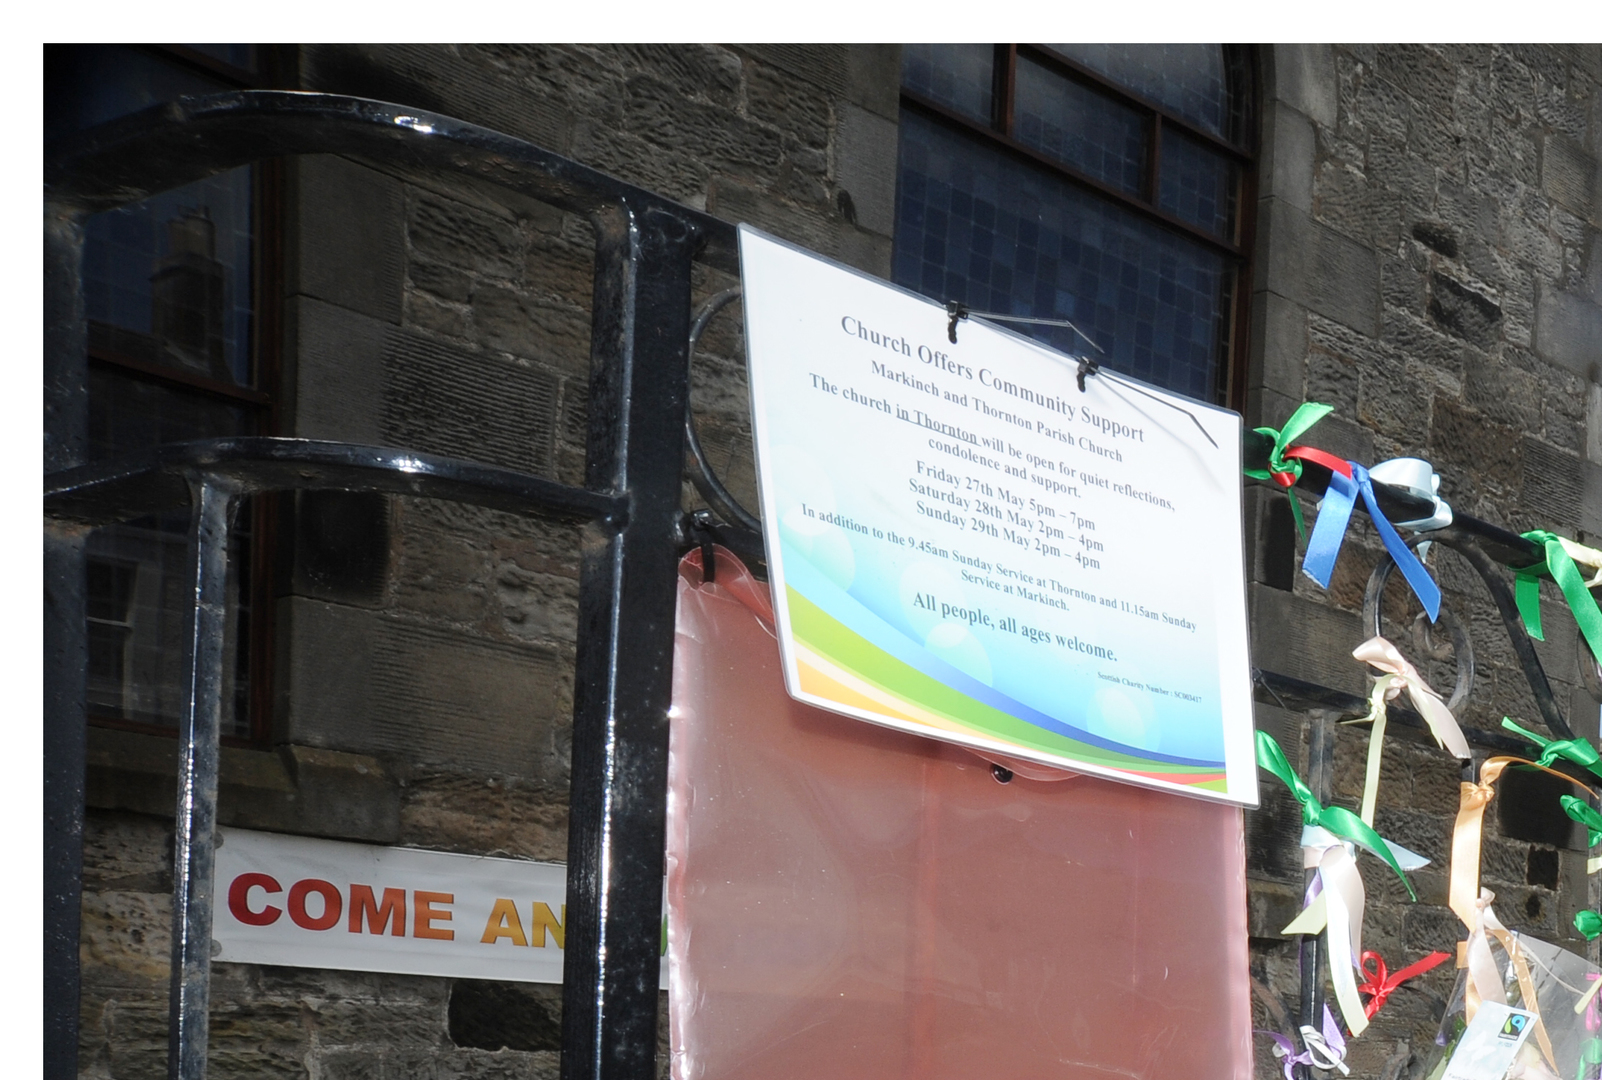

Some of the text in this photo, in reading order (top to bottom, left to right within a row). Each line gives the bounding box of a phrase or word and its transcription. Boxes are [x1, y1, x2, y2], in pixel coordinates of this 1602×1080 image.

[840, 315, 1144, 443] Church Offers Community Support
[871, 359, 1123, 463] Markinch and Thornton Parish Church
[809, 372, 1175, 512] The church in Thornton will be open for quiet reflections,
[928, 438, 1081, 499] condolence and support.
[908, 478, 971, 513] Saturday
[974, 498, 1003, 520] 28th
[1006, 509, 1034, 533] May
[1038, 519, 1064, 540] 2pm
[1078, 533, 1104, 552] 4pm
[916, 459, 961, 490] Friday
[965, 476, 994, 498] 27th
[997, 486, 1025, 511] May
[1029, 497, 1056, 518] 5pm
[1069, 511, 1096, 531] 7pm
[802, 503, 1196, 633] In addition to the 9.45am Sunday Service at Thornton and 11.15am Sunday
[916, 500, 967, 531] Sunday
[970, 517, 999, 538] 29th
[1003, 527, 1031, 551] May
[1034, 537, 1061, 558] 2pm
[1074, 551, 1101, 570] 4pm
[961, 569, 1070, 611] Service at Markinch.
[913, 592, 1118, 662] All people, all ages welcome.
[1097, 671, 1121, 684] Scottish
[1121, 677, 1144, 691] Charity
[1145, 683, 1170, 696] Number
[228, 872, 566, 949] COME AN
